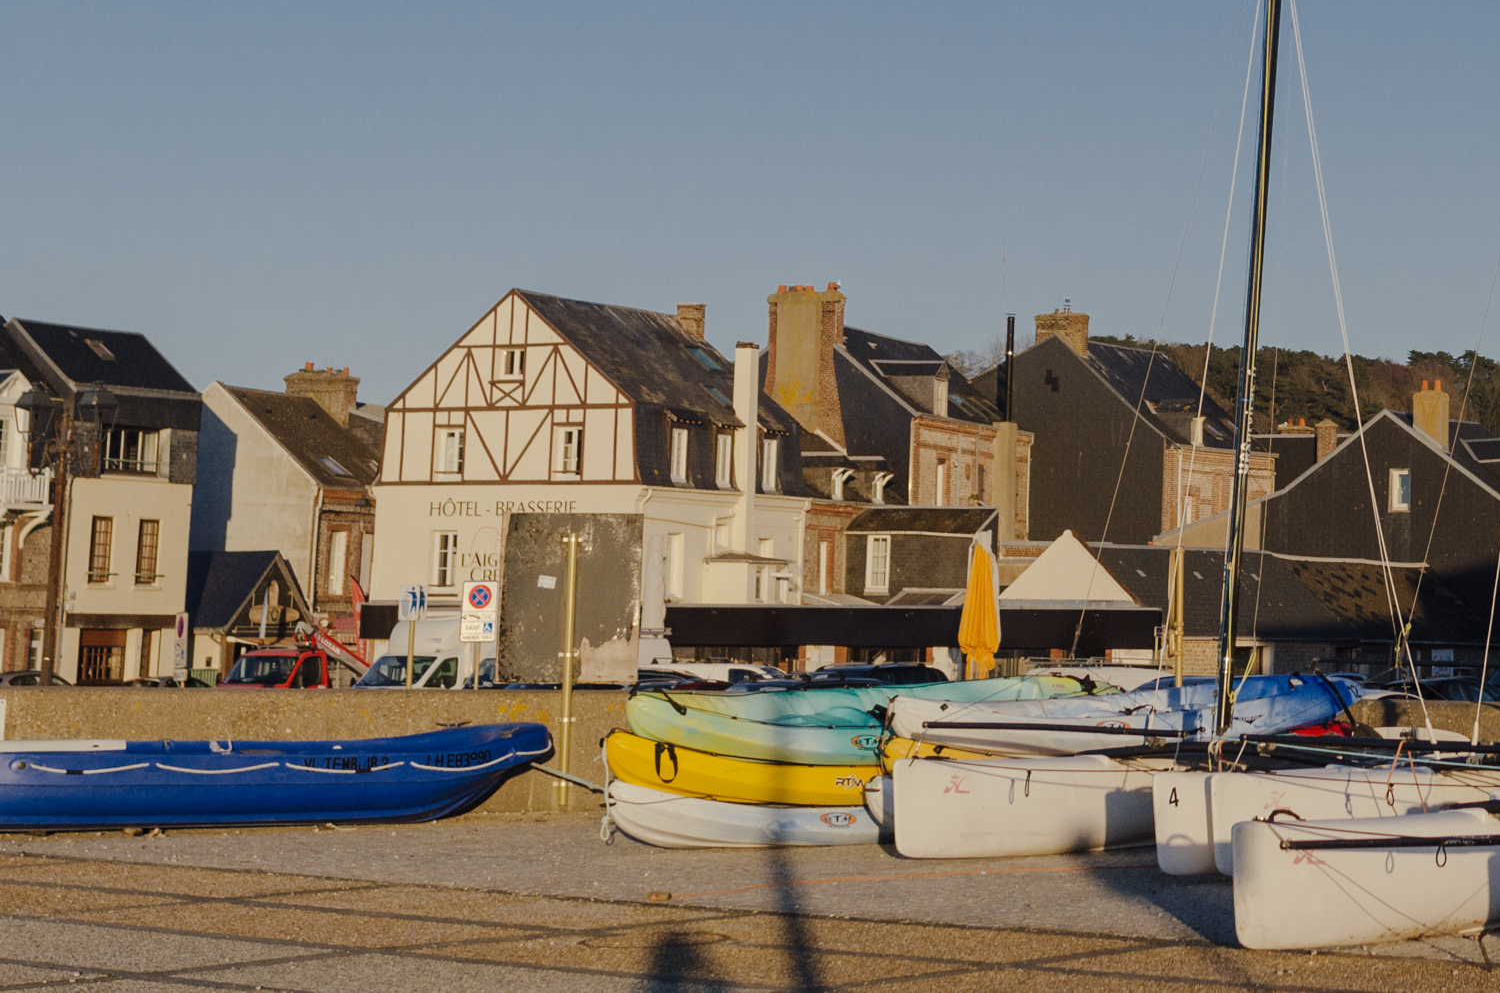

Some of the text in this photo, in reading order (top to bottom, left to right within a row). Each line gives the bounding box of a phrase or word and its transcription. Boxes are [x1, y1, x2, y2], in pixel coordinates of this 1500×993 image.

[429, 497, 482, 517] HÔTEL
[495, 500, 577, 517] BRASSERIE
[1169, 787, 1179, 807] 4
